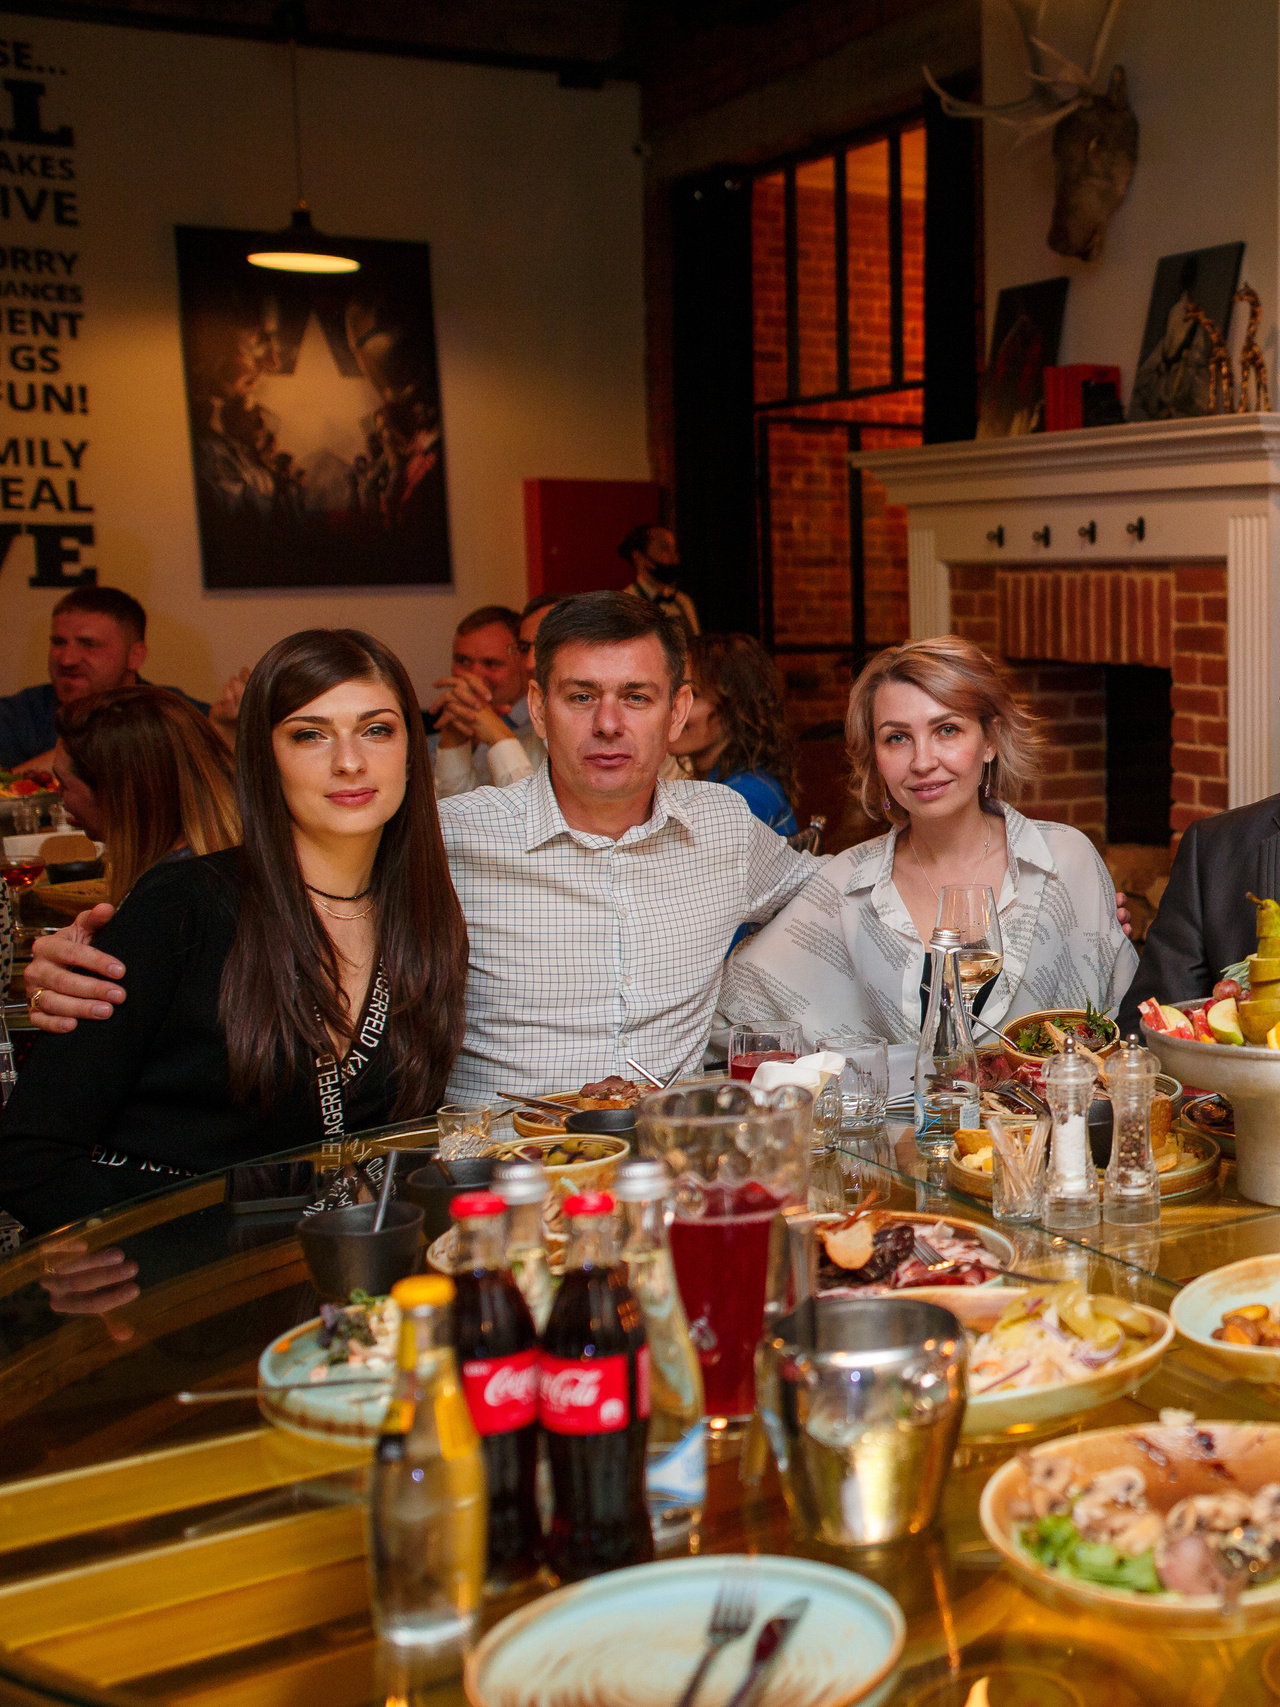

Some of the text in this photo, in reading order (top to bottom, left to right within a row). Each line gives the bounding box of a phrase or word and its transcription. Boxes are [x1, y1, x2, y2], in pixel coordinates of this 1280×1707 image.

[0, 78, 75, 147] L
[0, 280, 83, 304] ANCES
[0, 307, 84, 339] ENT
[9, 344, 60, 374] GS
[0, 381, 89, 415] UN!
[0, 476, 94, 512] EAL
[359, 956, 390, 1048] GERFELD
[315, 1053, 345, 1137] AGERFELD
